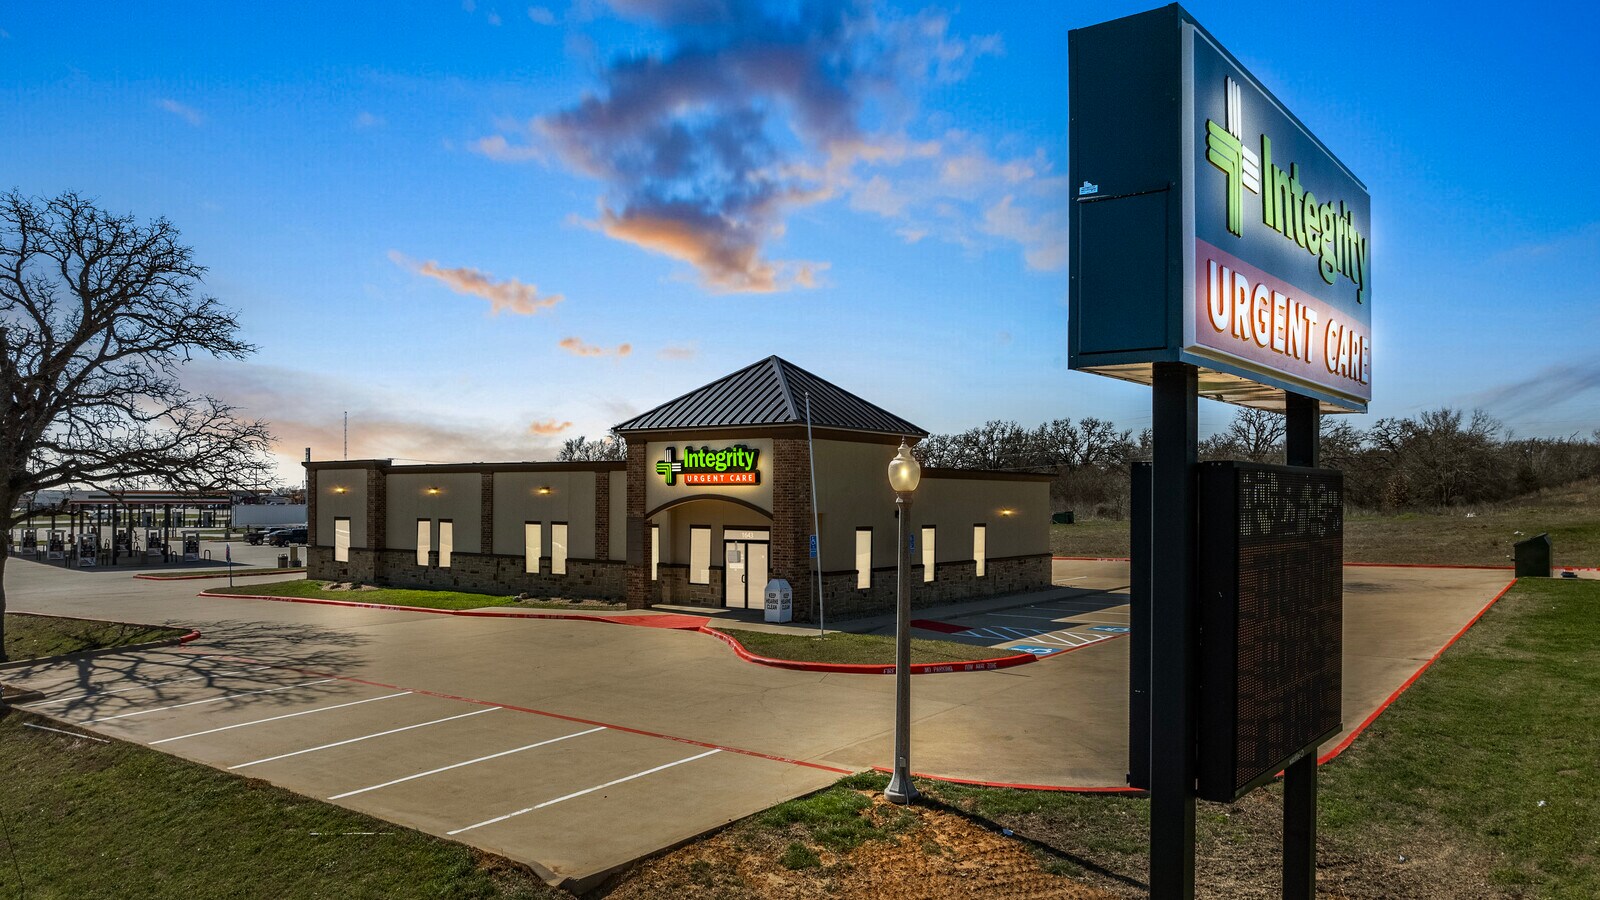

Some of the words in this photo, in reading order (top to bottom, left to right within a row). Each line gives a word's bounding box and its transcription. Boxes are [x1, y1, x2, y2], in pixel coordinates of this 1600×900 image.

[1261, 133, 1366, 304] Integrity
[1207, 260, 1318, 363] URGENT
[1324, 318, 1369, 385] CARE
[684, 447, 754, 471] Integrity
[687, 474, 724, 482] URGENT
